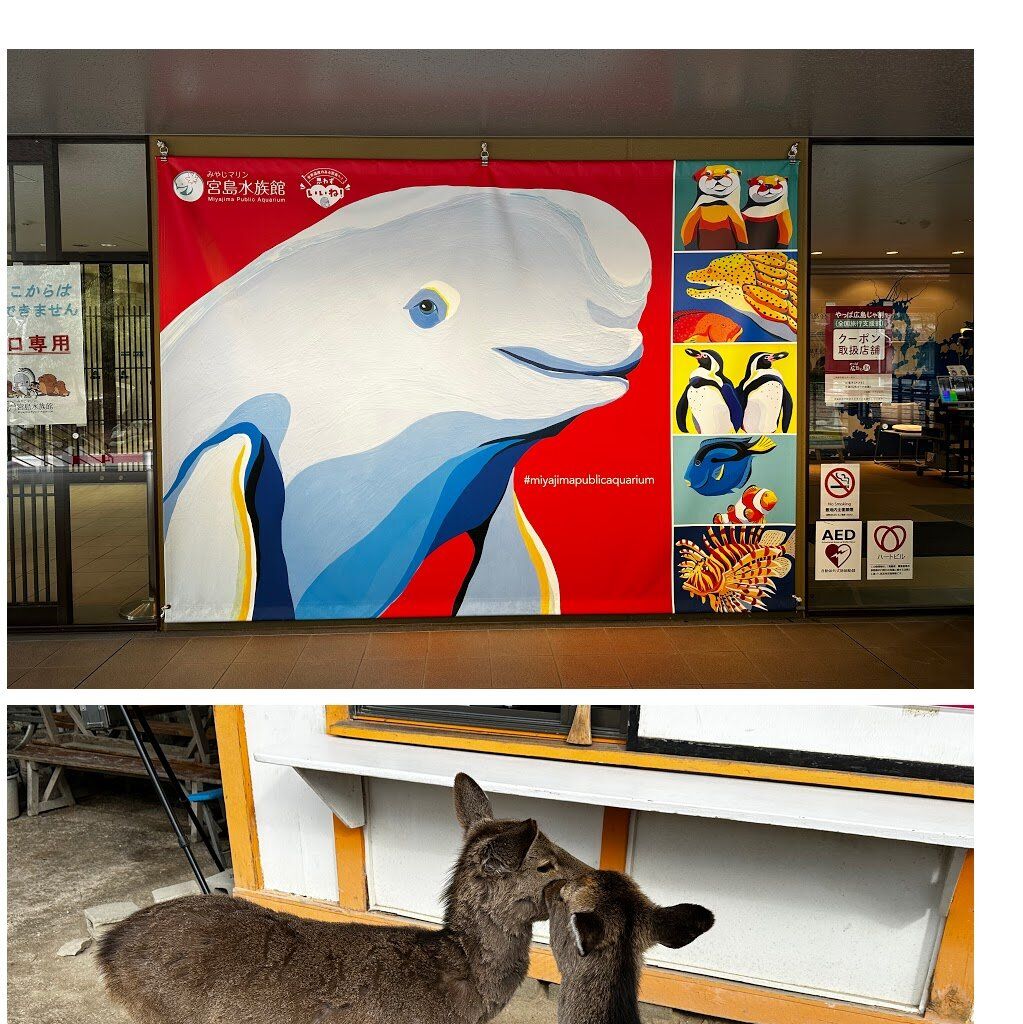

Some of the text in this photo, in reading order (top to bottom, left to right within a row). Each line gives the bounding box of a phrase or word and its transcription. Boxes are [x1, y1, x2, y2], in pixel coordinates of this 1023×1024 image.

[206, 171, 249, 179] みやじマリン
[206, 180, 286, 196] 宮島水族館
[11, 283, 72, 298] こからは
[7, 303, 79, 318] できません
[8, 334, 71, 353] 口専用
[838, 333, 881, 344] クーポン
[838, 345, 881, 356] 取扱店舗
[523, 475, 655, 487] #miyajimapublicaquarium
[822, 529, 856, 541] AED
